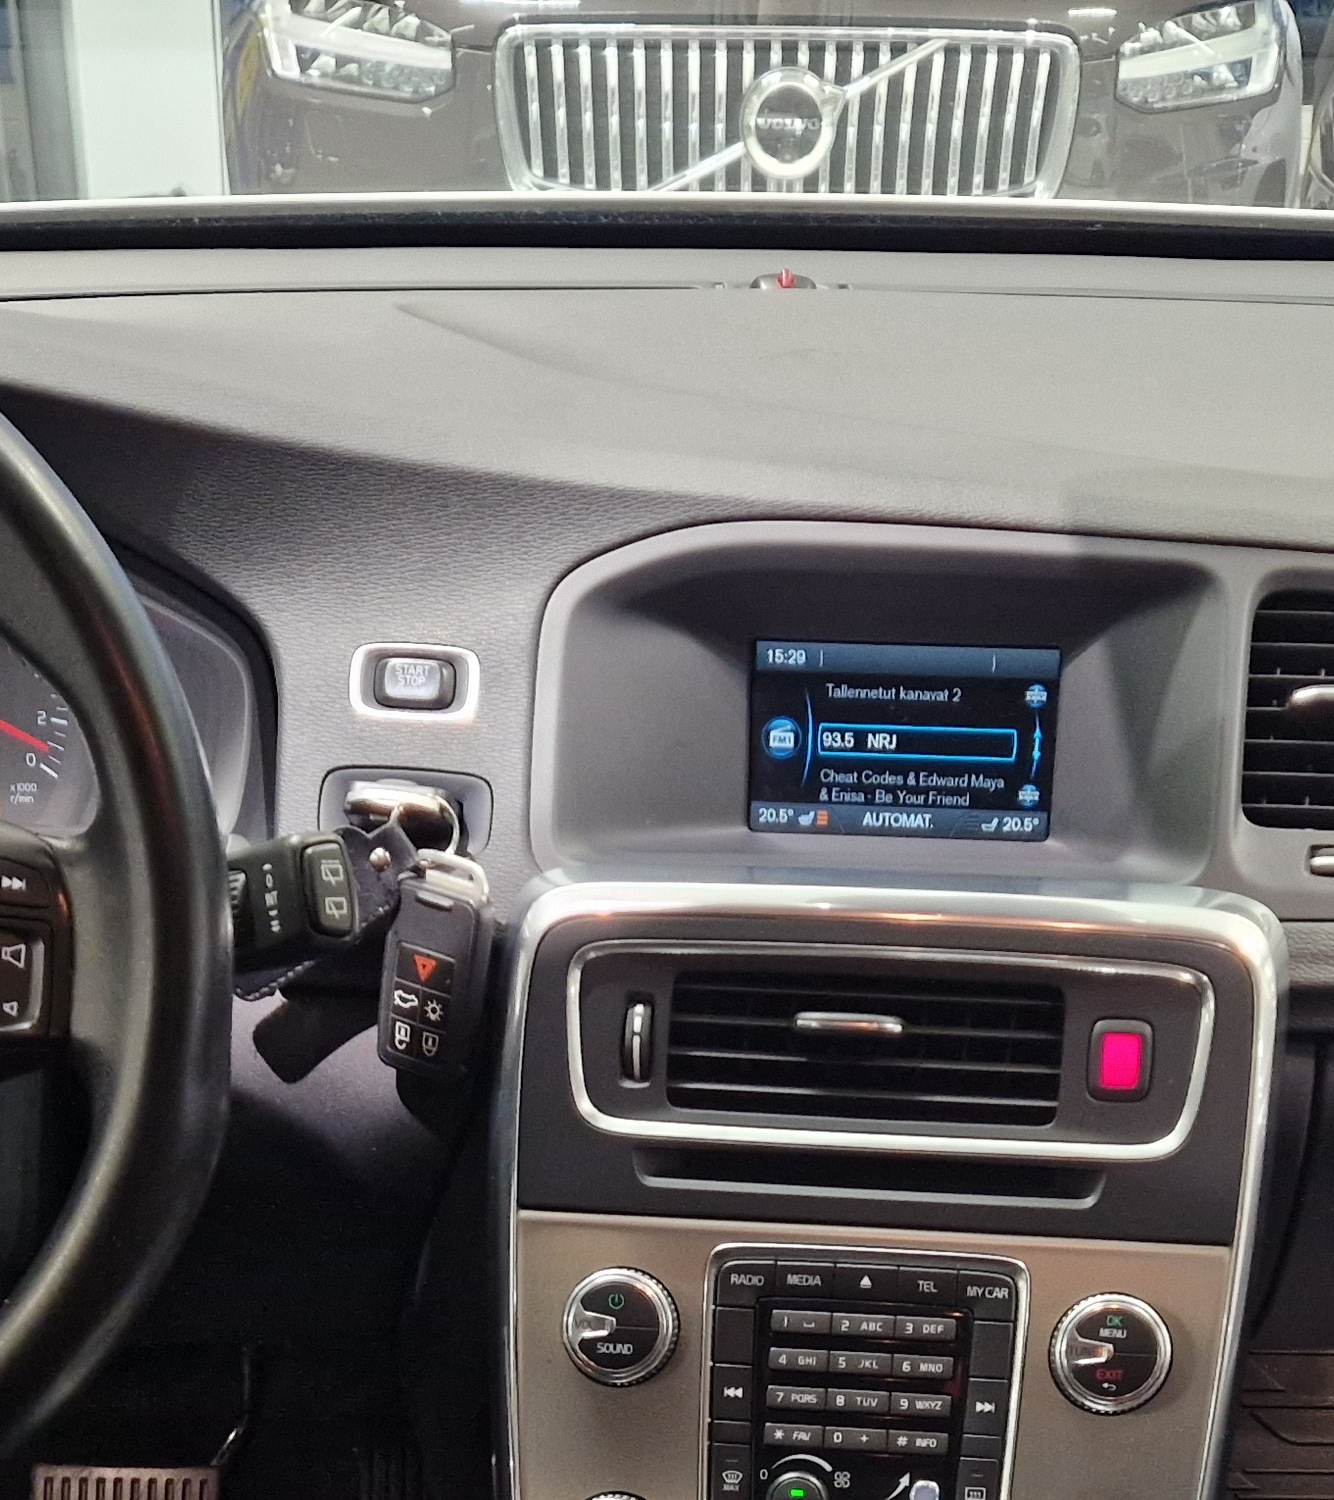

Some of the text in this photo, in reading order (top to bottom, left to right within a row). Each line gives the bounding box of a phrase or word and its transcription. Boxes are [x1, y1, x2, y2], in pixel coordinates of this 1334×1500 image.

[767, 649, 806, 665] 15:29
[395, 664, 430, 676] START
[397, 675, 426, 687] STOP
[826, 683, 962, 702] Tallennetut kanavat 2
[37, 711, 47, 726] 2
[822, 732, 897, 749] 93.5 NRJ
[26, 753, 36, 767] 0
[820, 769, 1005, 790] Cheat Codes & Edward Maya
[819, 788, 829, 802] &
[832, 788, 865, 803] Enisa
[876, 789, 892, 804] Be
[896, 791, 927, 805] Your
[931, 791, 970, 806] Friend
[862, 812, 934, 829] AUTOMAT.
[730, 1274, 764, 1287] RADIO
[787, 1274, 821, 1287] MEDIA
[917, 1280, 937, 1293] TEL
[841, 1320, 882, 1332] 2 ABC
[905, 1322, 944, 1334] 3 DEF
[1099, 1328, 1127, 1339] MENU
[597, 1342, 633, 1355] SOUND
[778, 1354, 816, 1366] 4 GHI
[838, 1357, 879, 1369] 5 JKL
[902, 1361, 943, 1373] 6 MNO
[775, 1392, 817, 1404] 7 PQRS
[836, 1394, 878, 1407] 8 TUV
[899, 1398, 942, 1411] 9 WXYZ
[793, 1430, 811, 1441] FAV
[833, 1433, 842, 1444] 0
[915, 1438, 937, 1448] INFO
